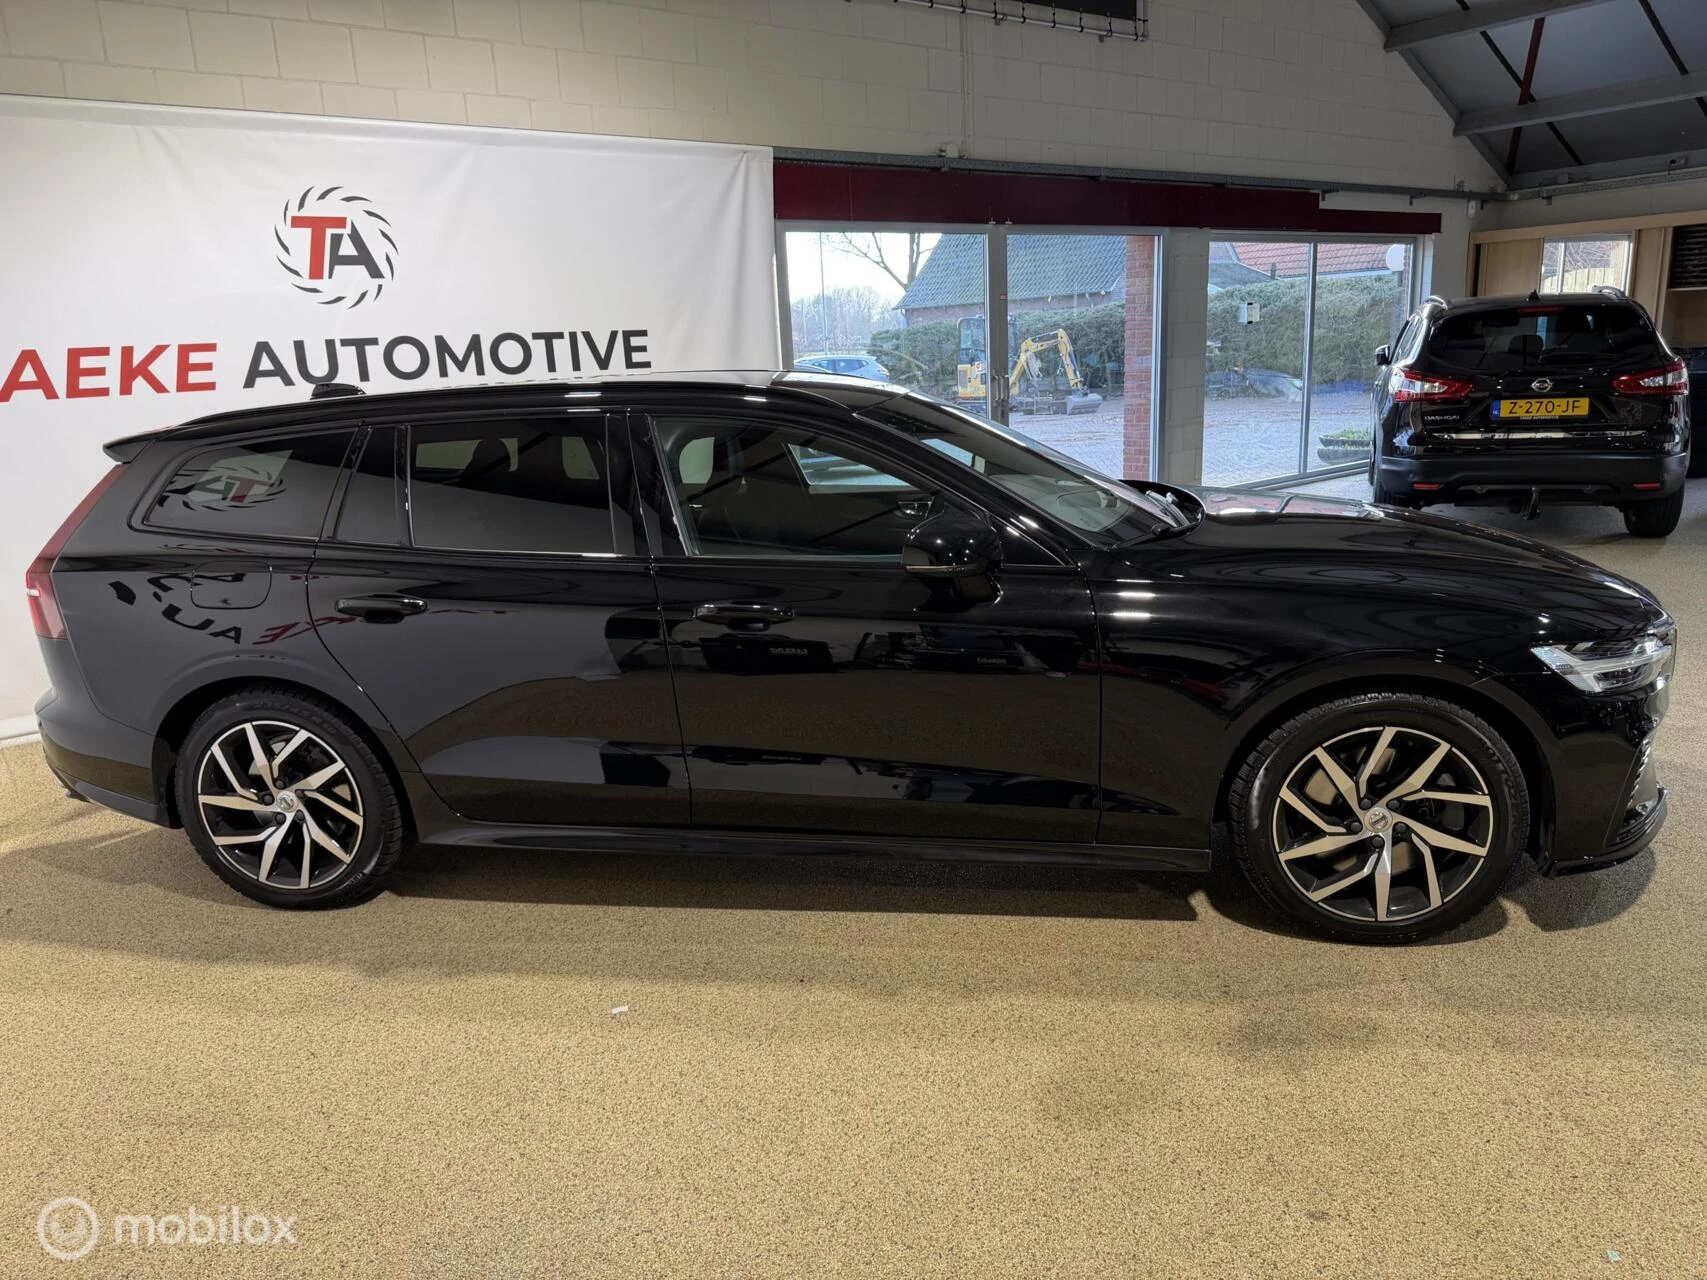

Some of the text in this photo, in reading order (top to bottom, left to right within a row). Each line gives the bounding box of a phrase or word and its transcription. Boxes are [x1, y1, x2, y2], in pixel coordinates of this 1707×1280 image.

[290, 215, 385, 280] TA
[242, 329, 652, 389] AUTOMOTIVE
[1508, 400, 1581, 415] Z-270-JF
